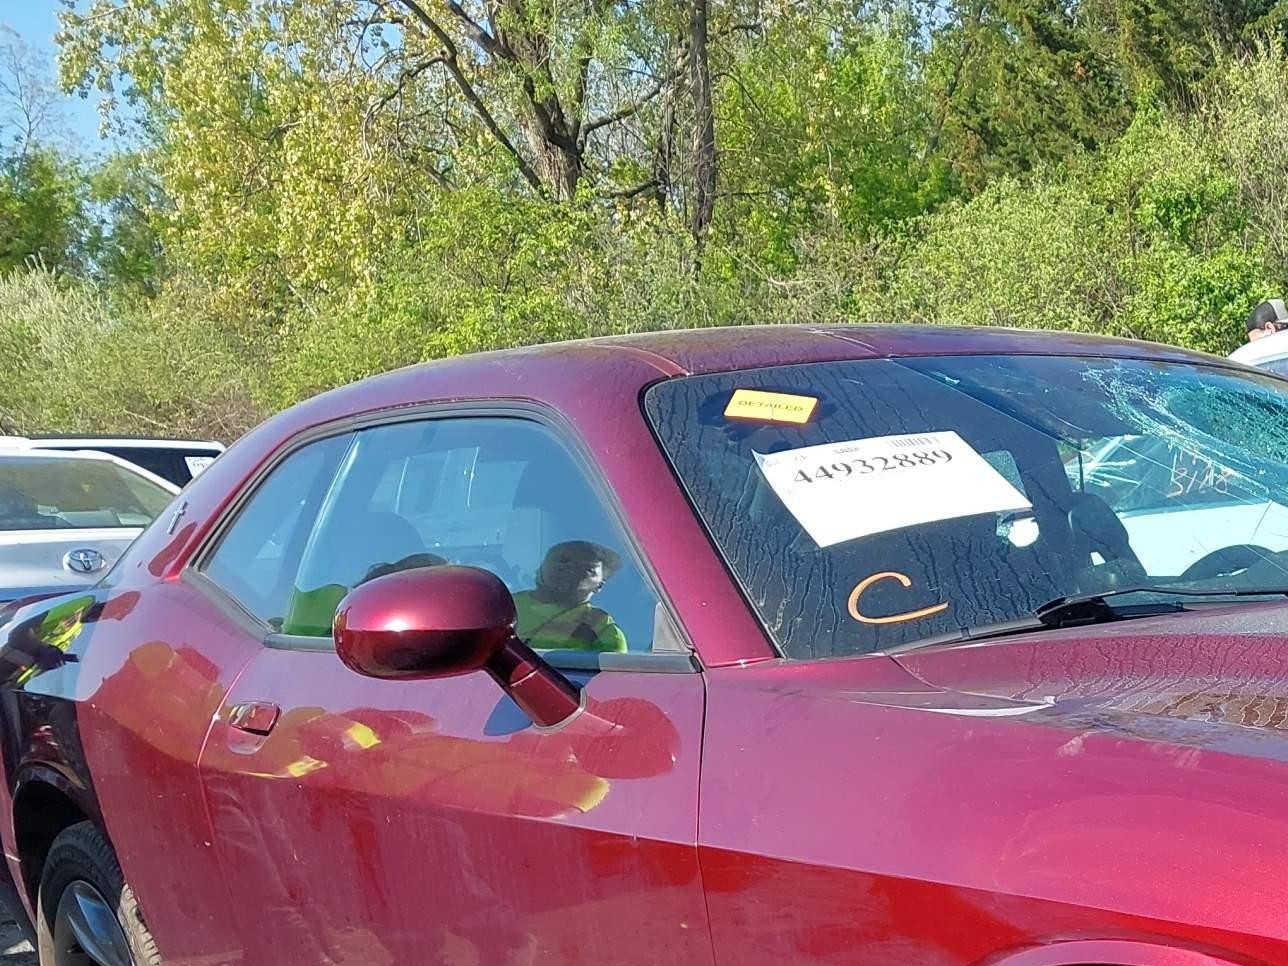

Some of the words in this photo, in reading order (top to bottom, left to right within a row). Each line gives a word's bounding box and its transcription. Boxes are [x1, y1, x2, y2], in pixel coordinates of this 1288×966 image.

[738, 400, 803, 412] DETAILED
[793, 449, 953, 484] 44932889
[847, 571, 949, 624] C
